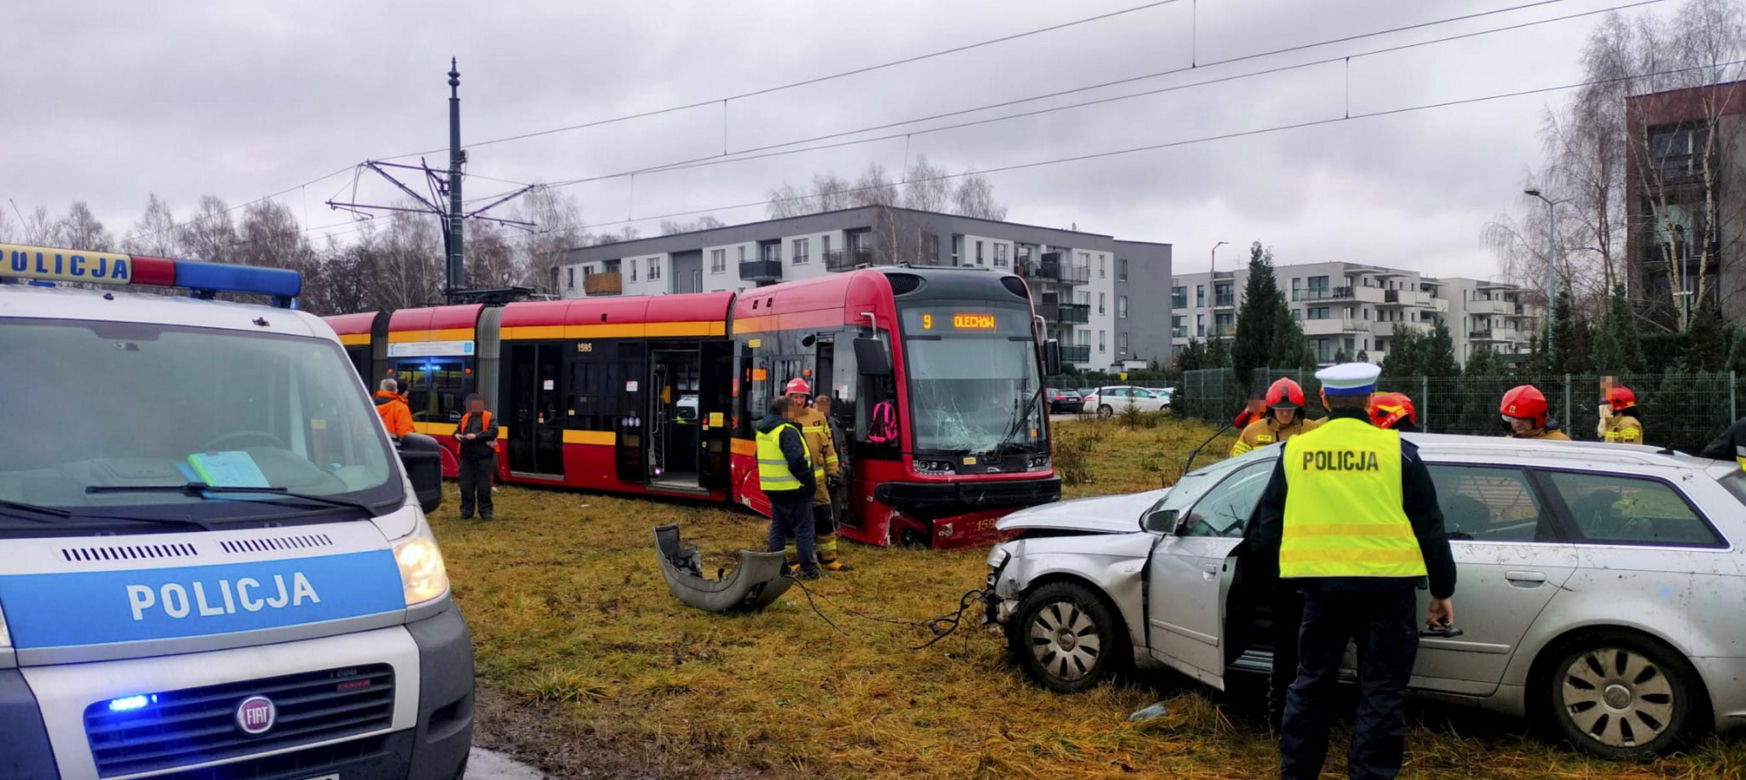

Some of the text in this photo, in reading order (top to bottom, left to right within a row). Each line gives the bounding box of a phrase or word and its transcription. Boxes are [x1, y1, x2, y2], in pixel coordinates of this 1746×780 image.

[0, 251, 128, 279] OLICJA
[923, 314, 932, 329] 9
[577, 342, 592, 352] 1595
[1303, 450, 1379, 471] POLICJA
[976, 518, 998, 531] 159
[126, 571, 320, 621] POLICJA
[246, 706, 268, 725] FIAT
